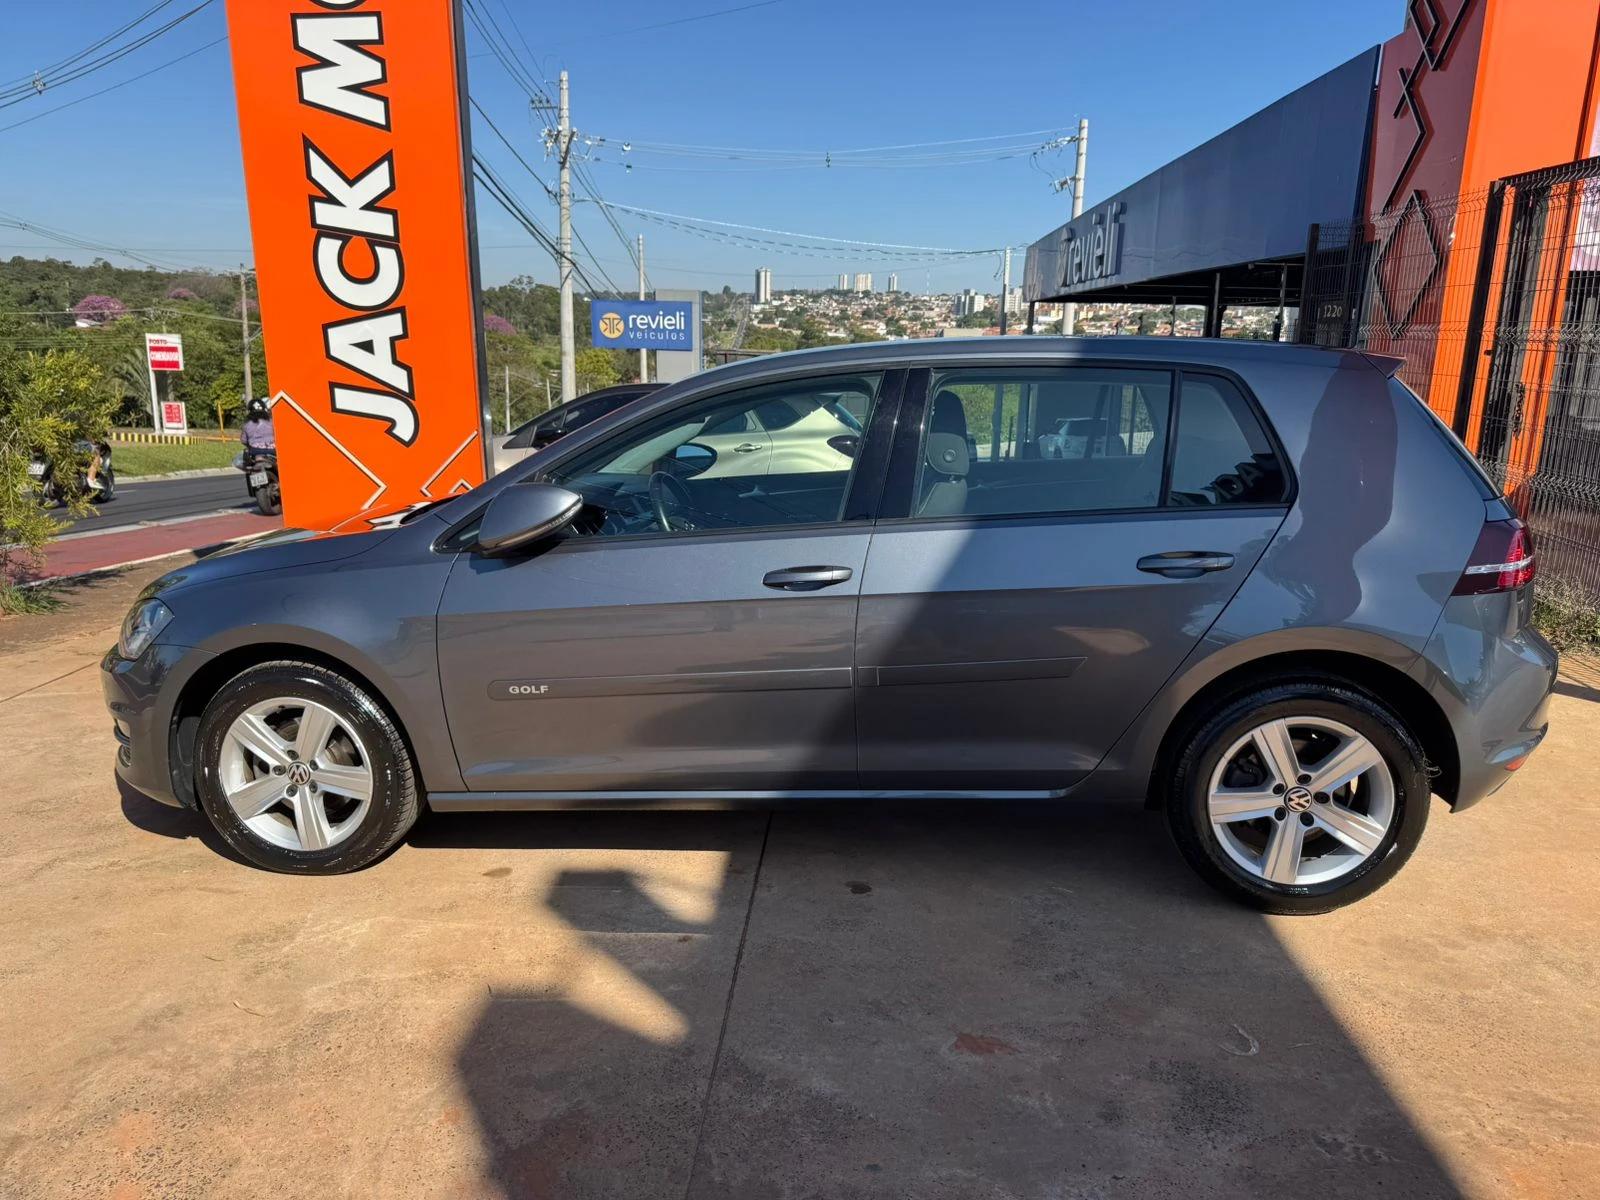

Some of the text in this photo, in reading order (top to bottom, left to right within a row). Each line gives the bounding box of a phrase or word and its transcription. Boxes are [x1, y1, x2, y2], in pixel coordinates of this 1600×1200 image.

[289, 0, 421, 448] JACK M
[1323, 305, 1342, 318] 1220
[628, 310, 685, 330] revieli
[509, 685, 549, 694] GOLF
